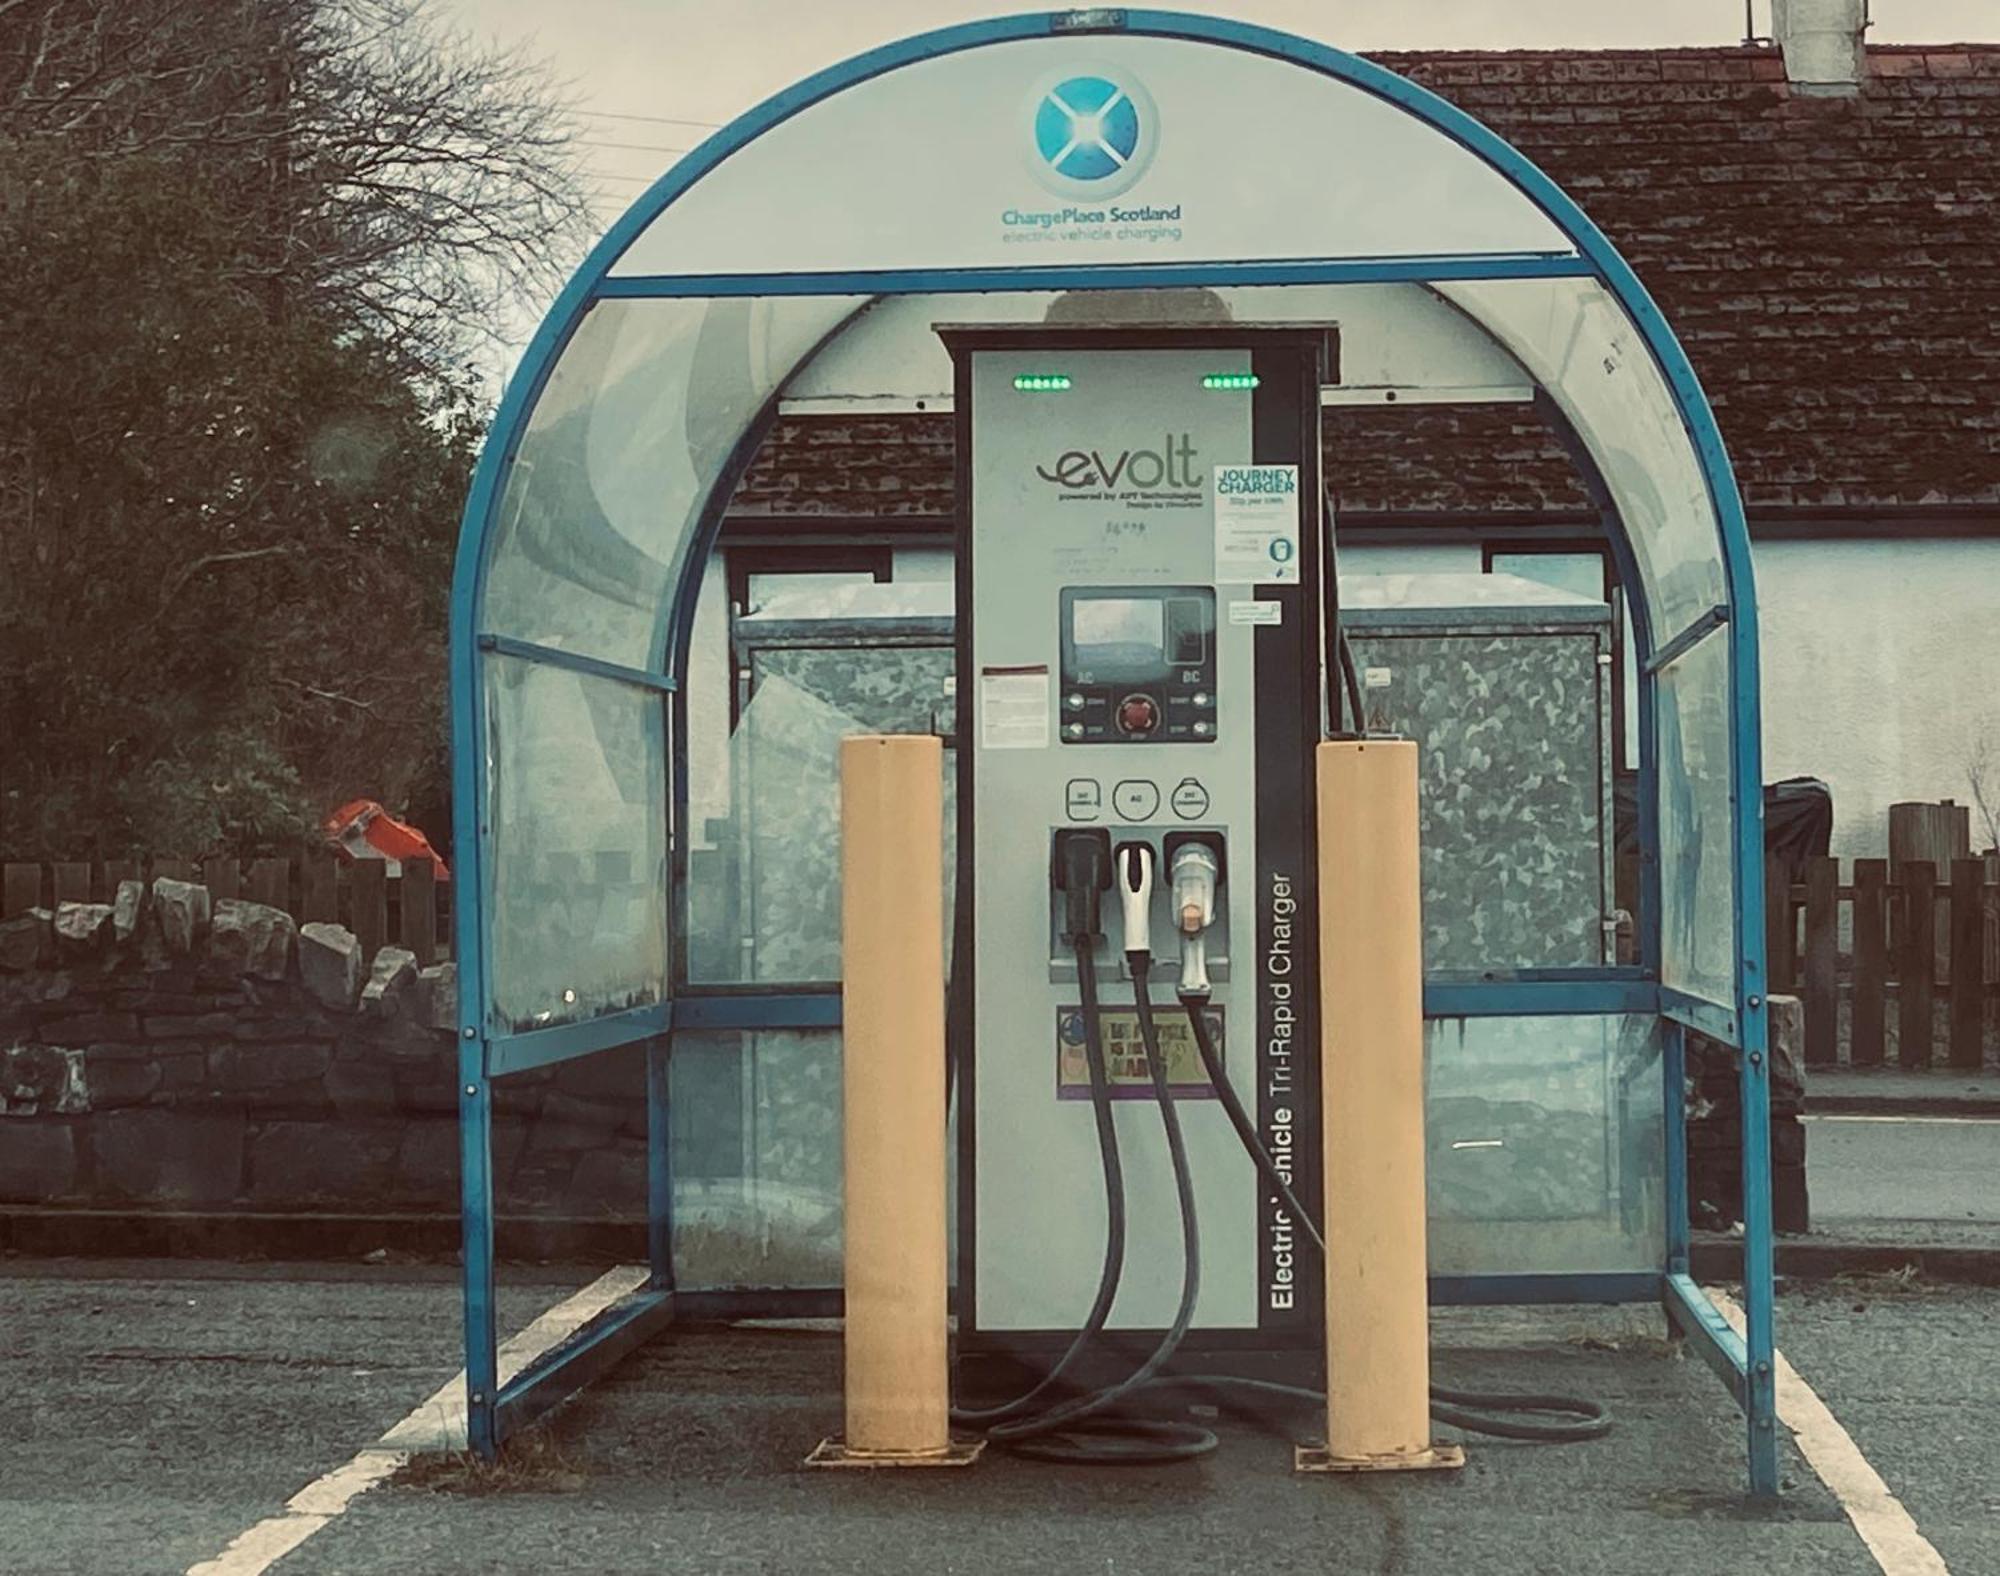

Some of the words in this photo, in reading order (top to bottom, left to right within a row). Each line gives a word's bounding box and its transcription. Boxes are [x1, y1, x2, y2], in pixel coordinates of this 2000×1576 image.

[1002, 207, 1105, 228] ChargePlace
[1110, 204, 1182, 222] Scotland
[1002, 230, 1056, 243] electric
[1060, 227, 1112, 241] vehicle
[1116, 225, 1182, 242] charging
[1036, 433, 1204, 489] evolt
[1218, 468, 1295, 482] JOURNEY
[1218, 480, 1295, 494] CHARGER
[1058, 490, 1102, 501] powered
[1104, 492, 1116, 502] by
[1077, 671, 1094, 684] AC
[1182, 670, 1200, 683] DC
[1267, 872, 1298, 976] Charger
[1268, 983, 1298, 1098] Tri-Rapid
